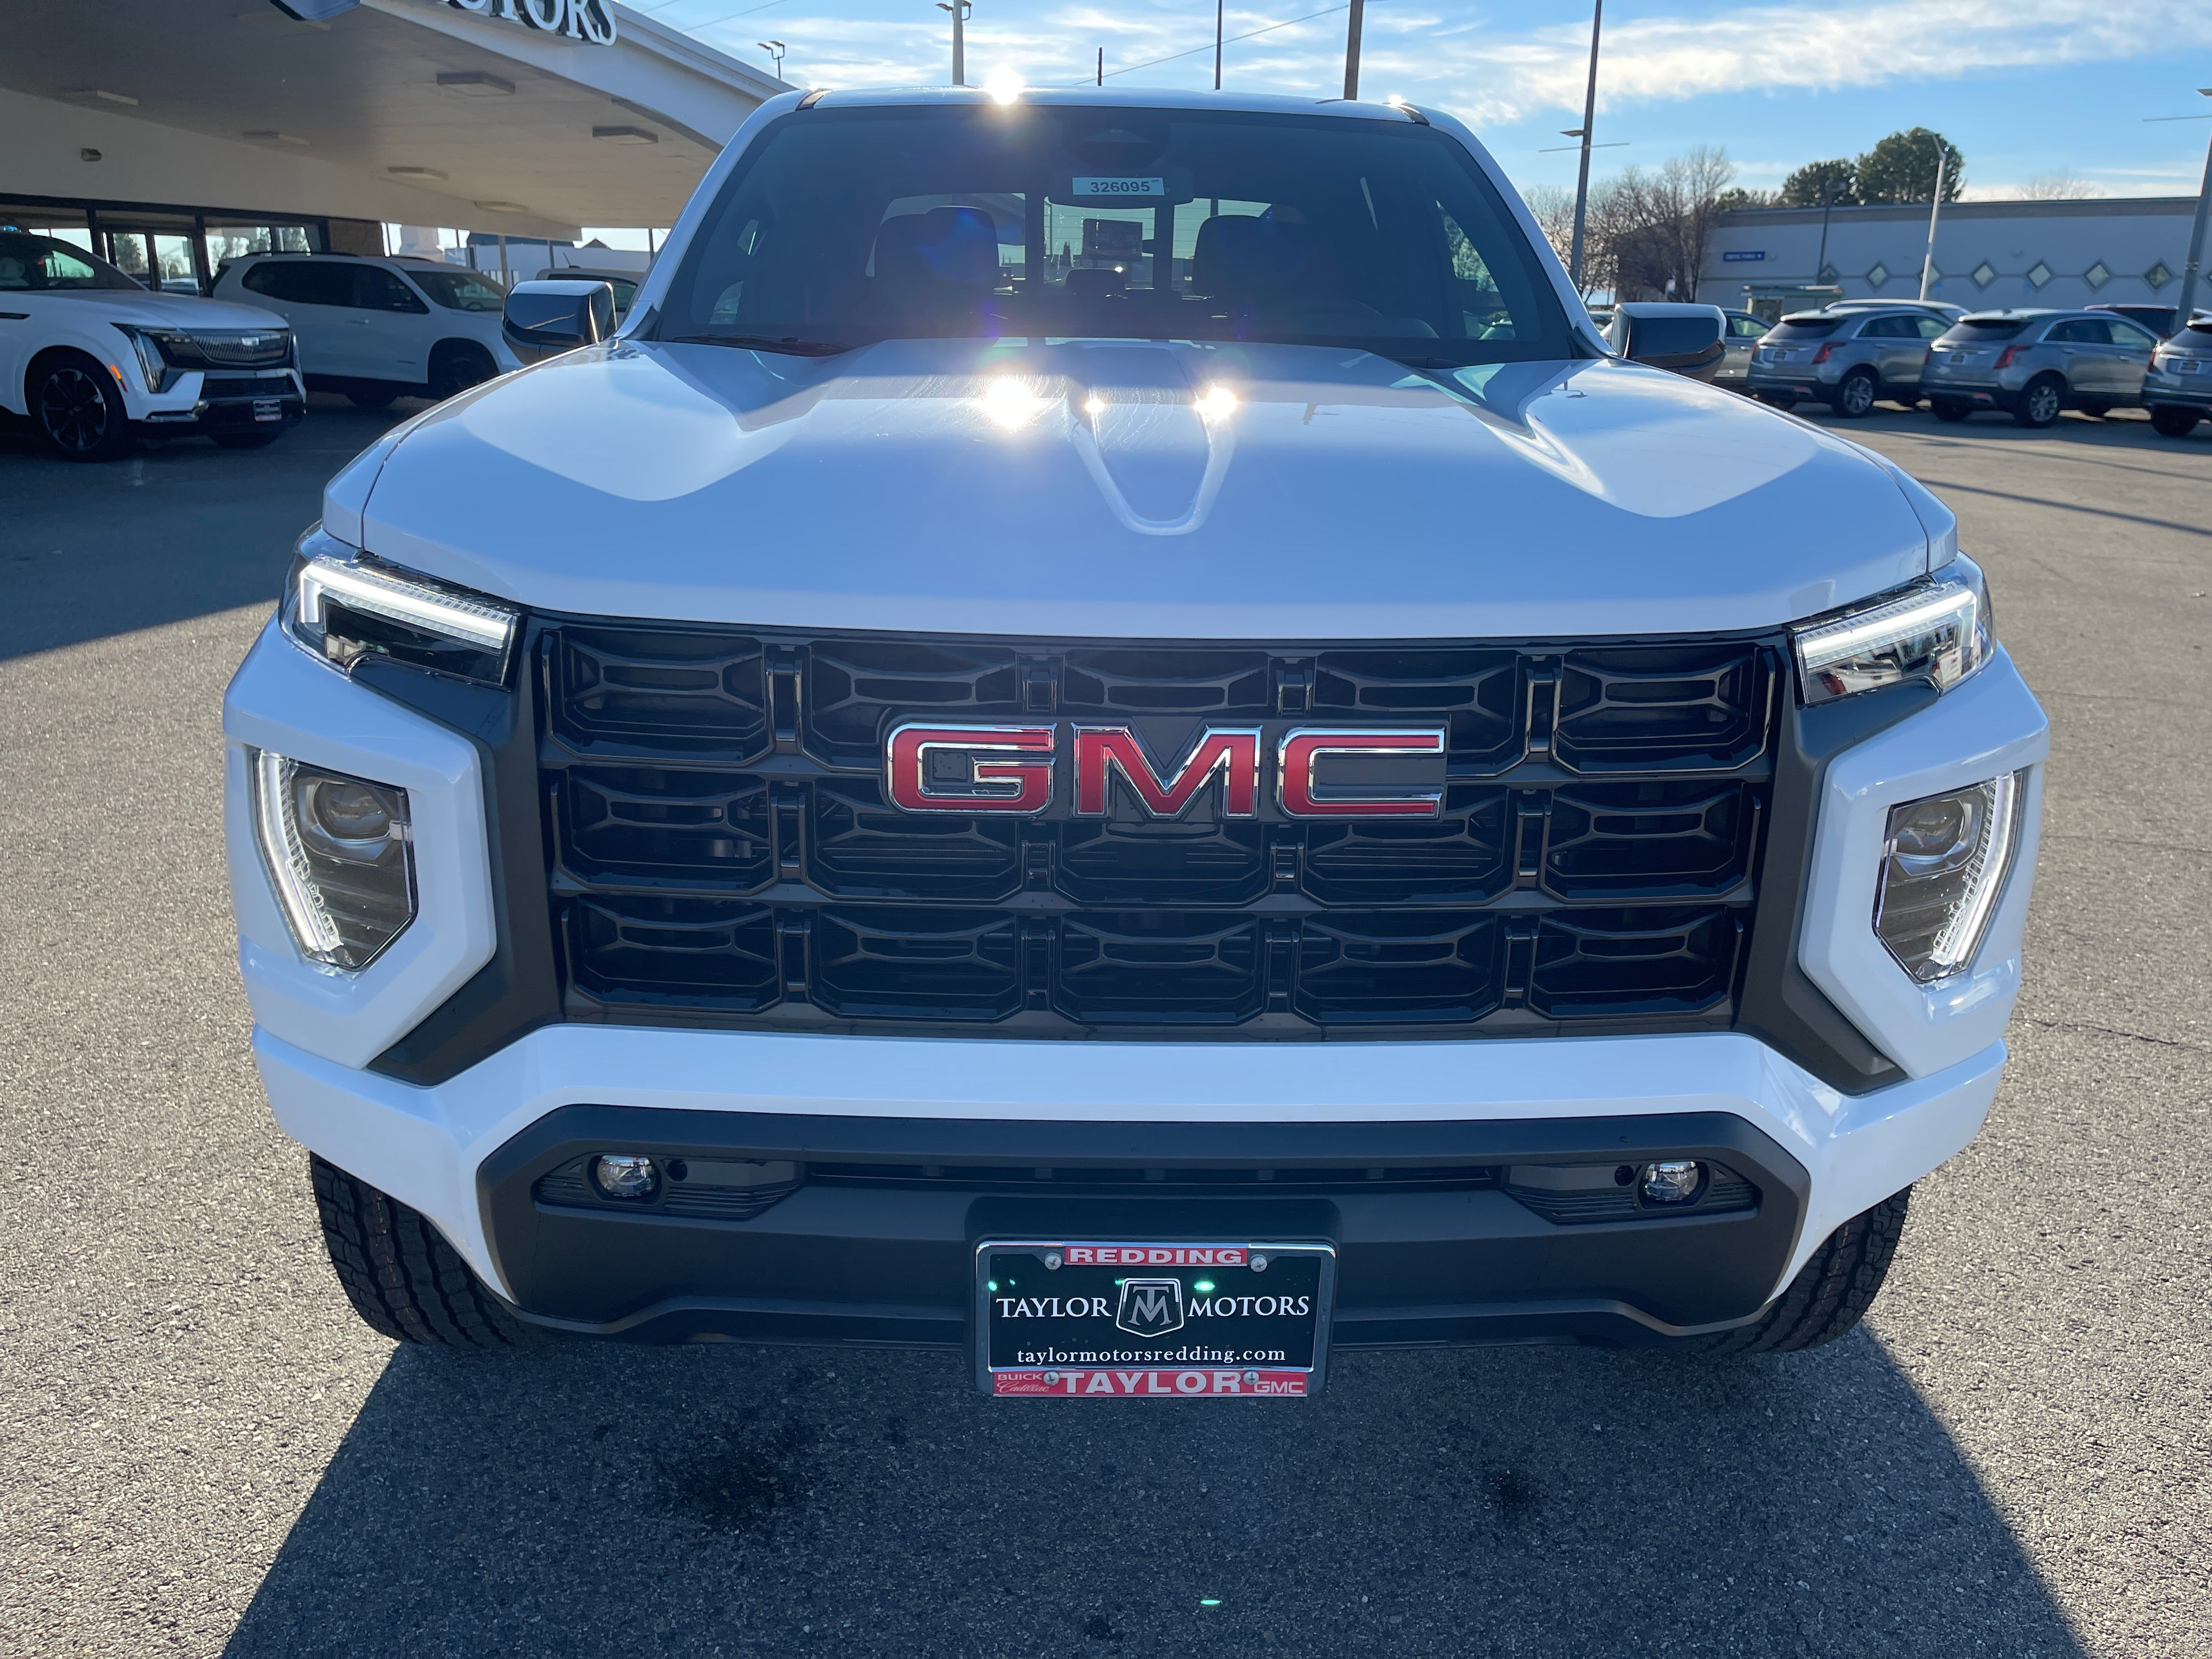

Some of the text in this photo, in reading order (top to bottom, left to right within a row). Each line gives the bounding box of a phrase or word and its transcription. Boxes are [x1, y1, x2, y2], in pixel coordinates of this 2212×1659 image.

[1090, 181, 1150, 193] 326095
[887, 722, 1446, 820] GMC
[1070, 1248, 1242, 1264] REDDING
[996, 1296, 1310, 1318] TAYLOR MOTORS
[1017, 1346, 1286, 1365] taylormotorsredding.com
[997, 1381, 1050, 1393] Cadillac
[1059, 1372, 1242, 1394] TAYLOR
[1254, 1381, 1304, 1393] GMC
